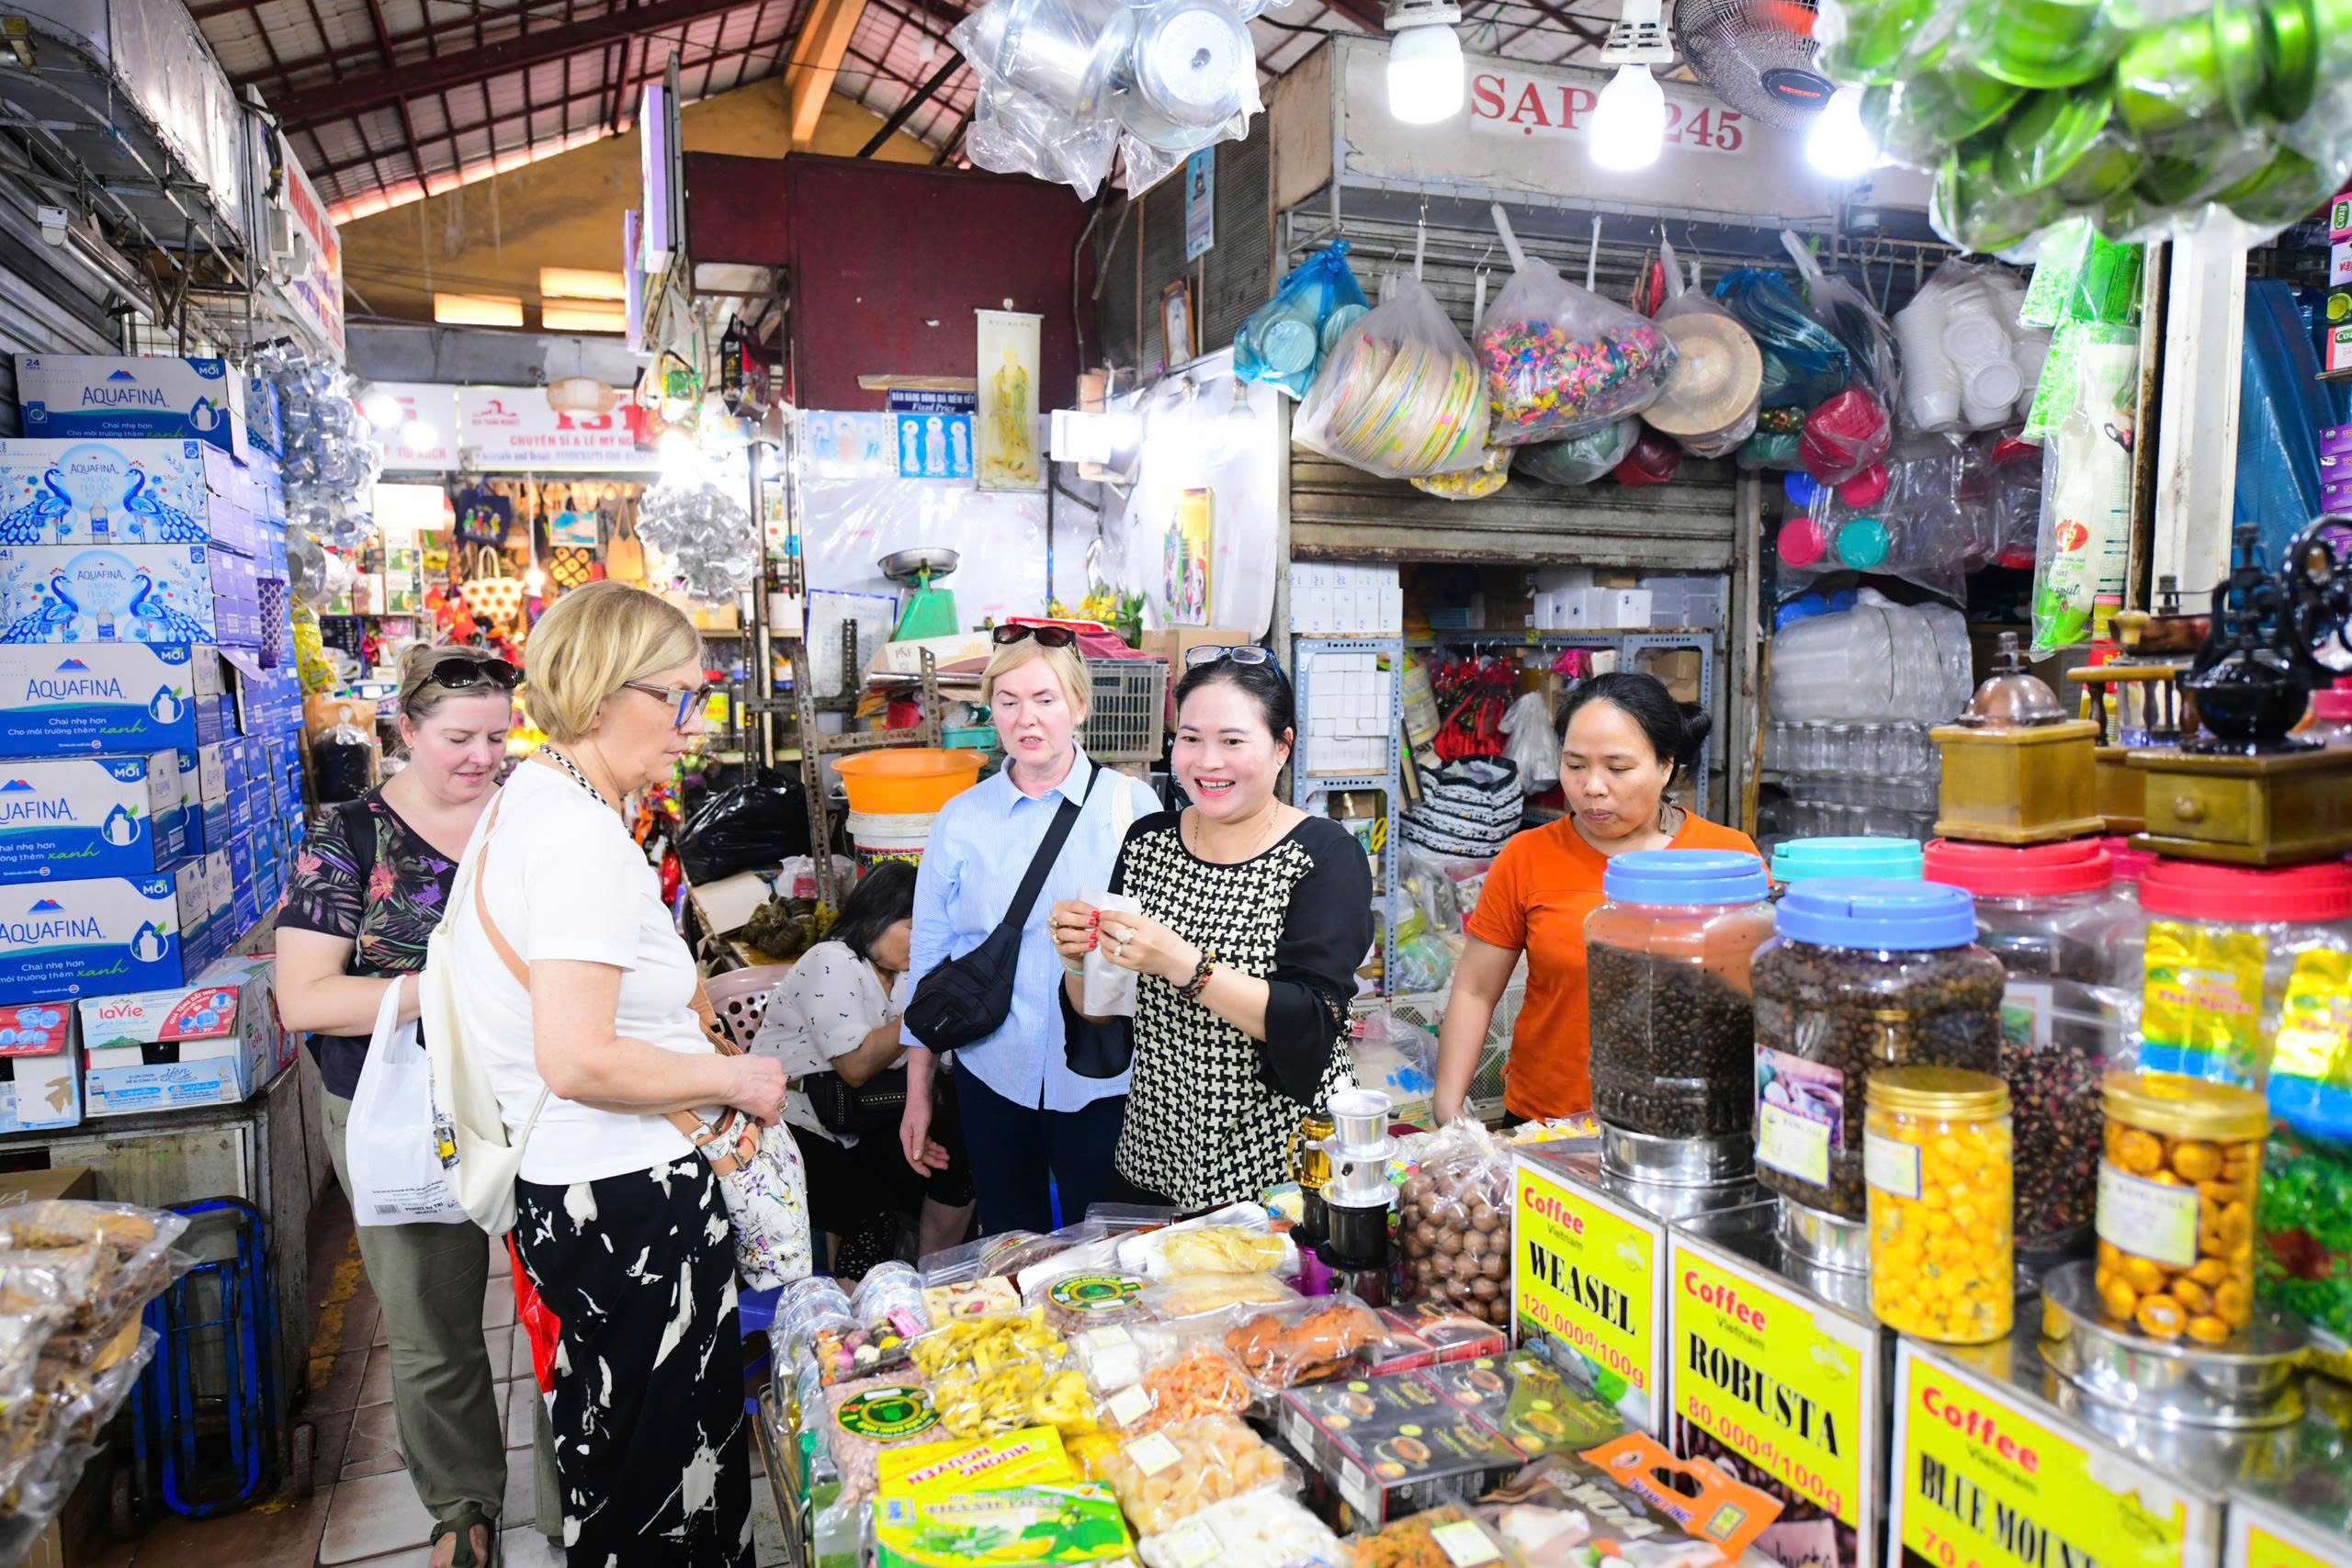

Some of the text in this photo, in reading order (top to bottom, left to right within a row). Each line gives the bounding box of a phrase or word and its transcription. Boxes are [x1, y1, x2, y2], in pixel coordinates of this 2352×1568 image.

[1472, 74, 1742, 152] SẠP 245
[82, 387, 168, 407] AQUAFINA
[912, 402, 956, 412] Fixed Price
[71, 463, 119, 475] AQUAFINA
[77, 570, 124, 581] AQUAFINA
[26, 678, 123, 700] AQUAFINA
[99, 718, 147, 734] xanh
[0, 798, 74, 824] UAFINA
[0, 841, 55, 852] hai nhẹ hơn
[19, 852, 44, 861] thêm
[48, 841, 101, 860] xanh
[0, 917, 102, 943] AQUAFINA
[17, 972, 46, 983] trường
[49, 970, 74, 980] thêm
[76, 958, 130, 977] xanh
[21, 959, 85, 972] Chai nhẹ hơn
[99, 1004, 144, 1020] laVie
[1524, 1187, 1583, 1235] Coffee
[1547, 1223, 1583, 1251] Vietnam
[1529, 1240, 1636, 1336] WEASEL
[1684, 1270, 1766, 1332] Coffee
[1716, 1315, 1766, 1351] Vietnam
[1689, 1331, 1841, 1458] ROBUSTA
[1922, 1386, 2039, 1473] Coffee
[1968, 1443, 2039, 1495] Vietnam
[1921, 1451, 1986, 1535] BLUE
